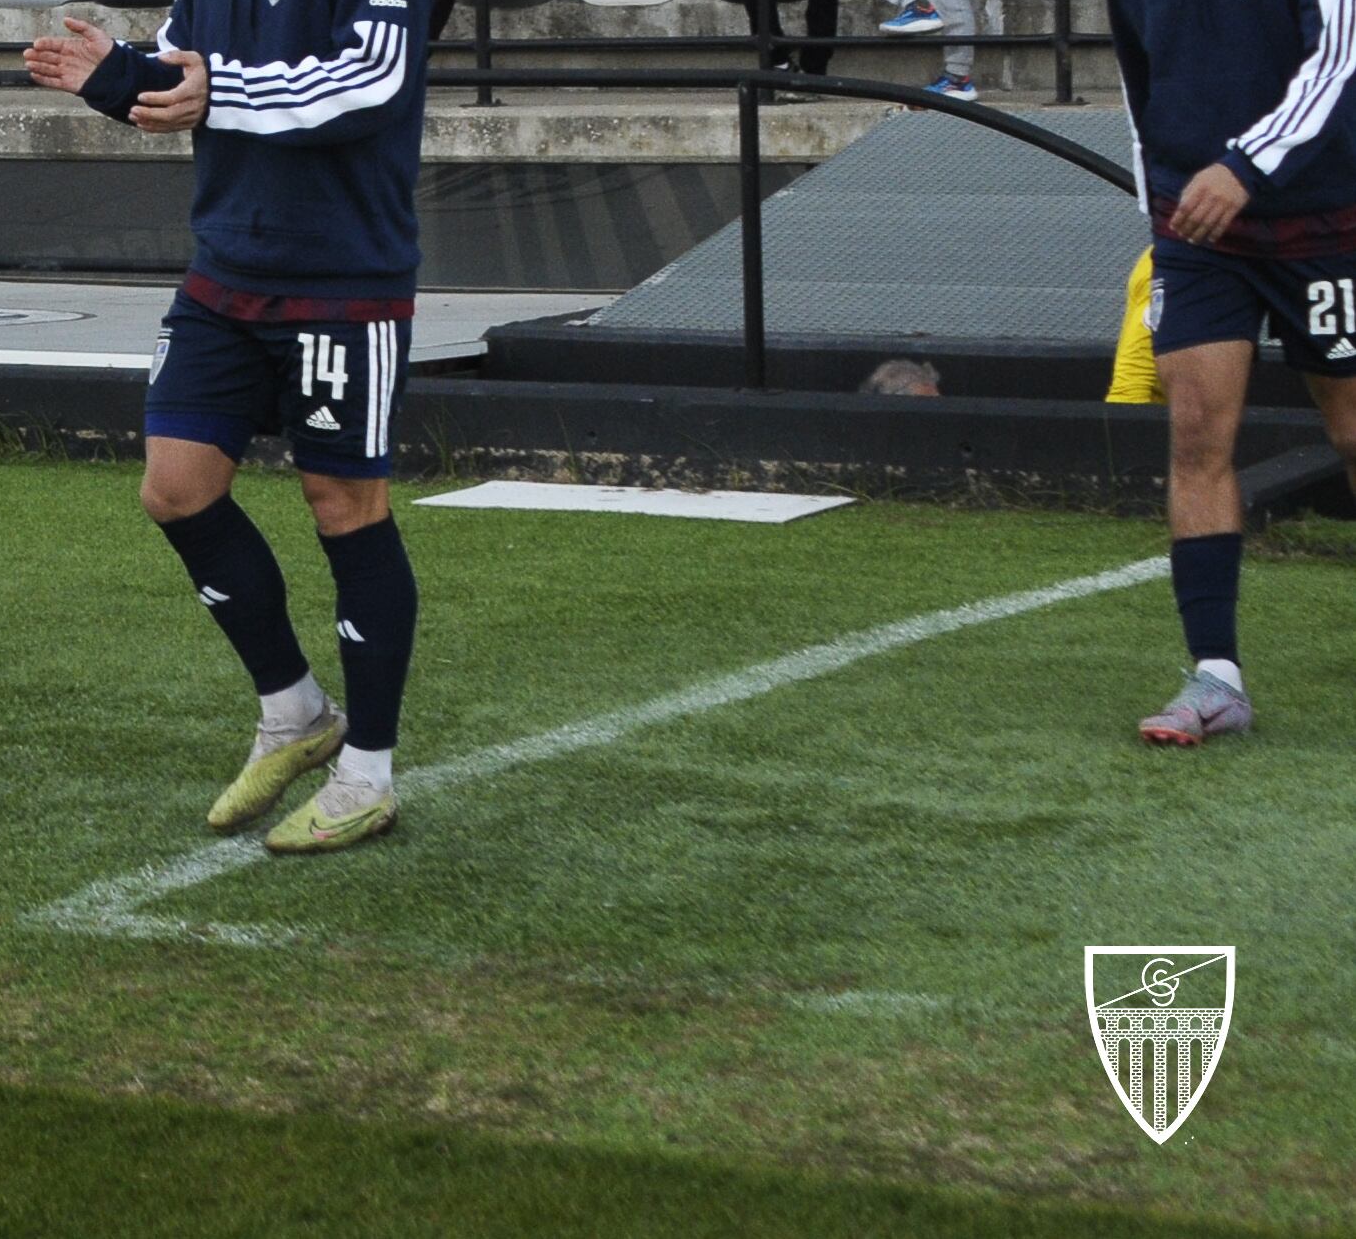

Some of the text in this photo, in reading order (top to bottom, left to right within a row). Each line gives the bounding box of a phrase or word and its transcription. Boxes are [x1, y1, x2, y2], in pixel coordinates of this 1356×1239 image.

[1308, 278, 1356, 335] 21
[298, 332, 349, 400] 14
[306, 418, 341, 431] adidas
